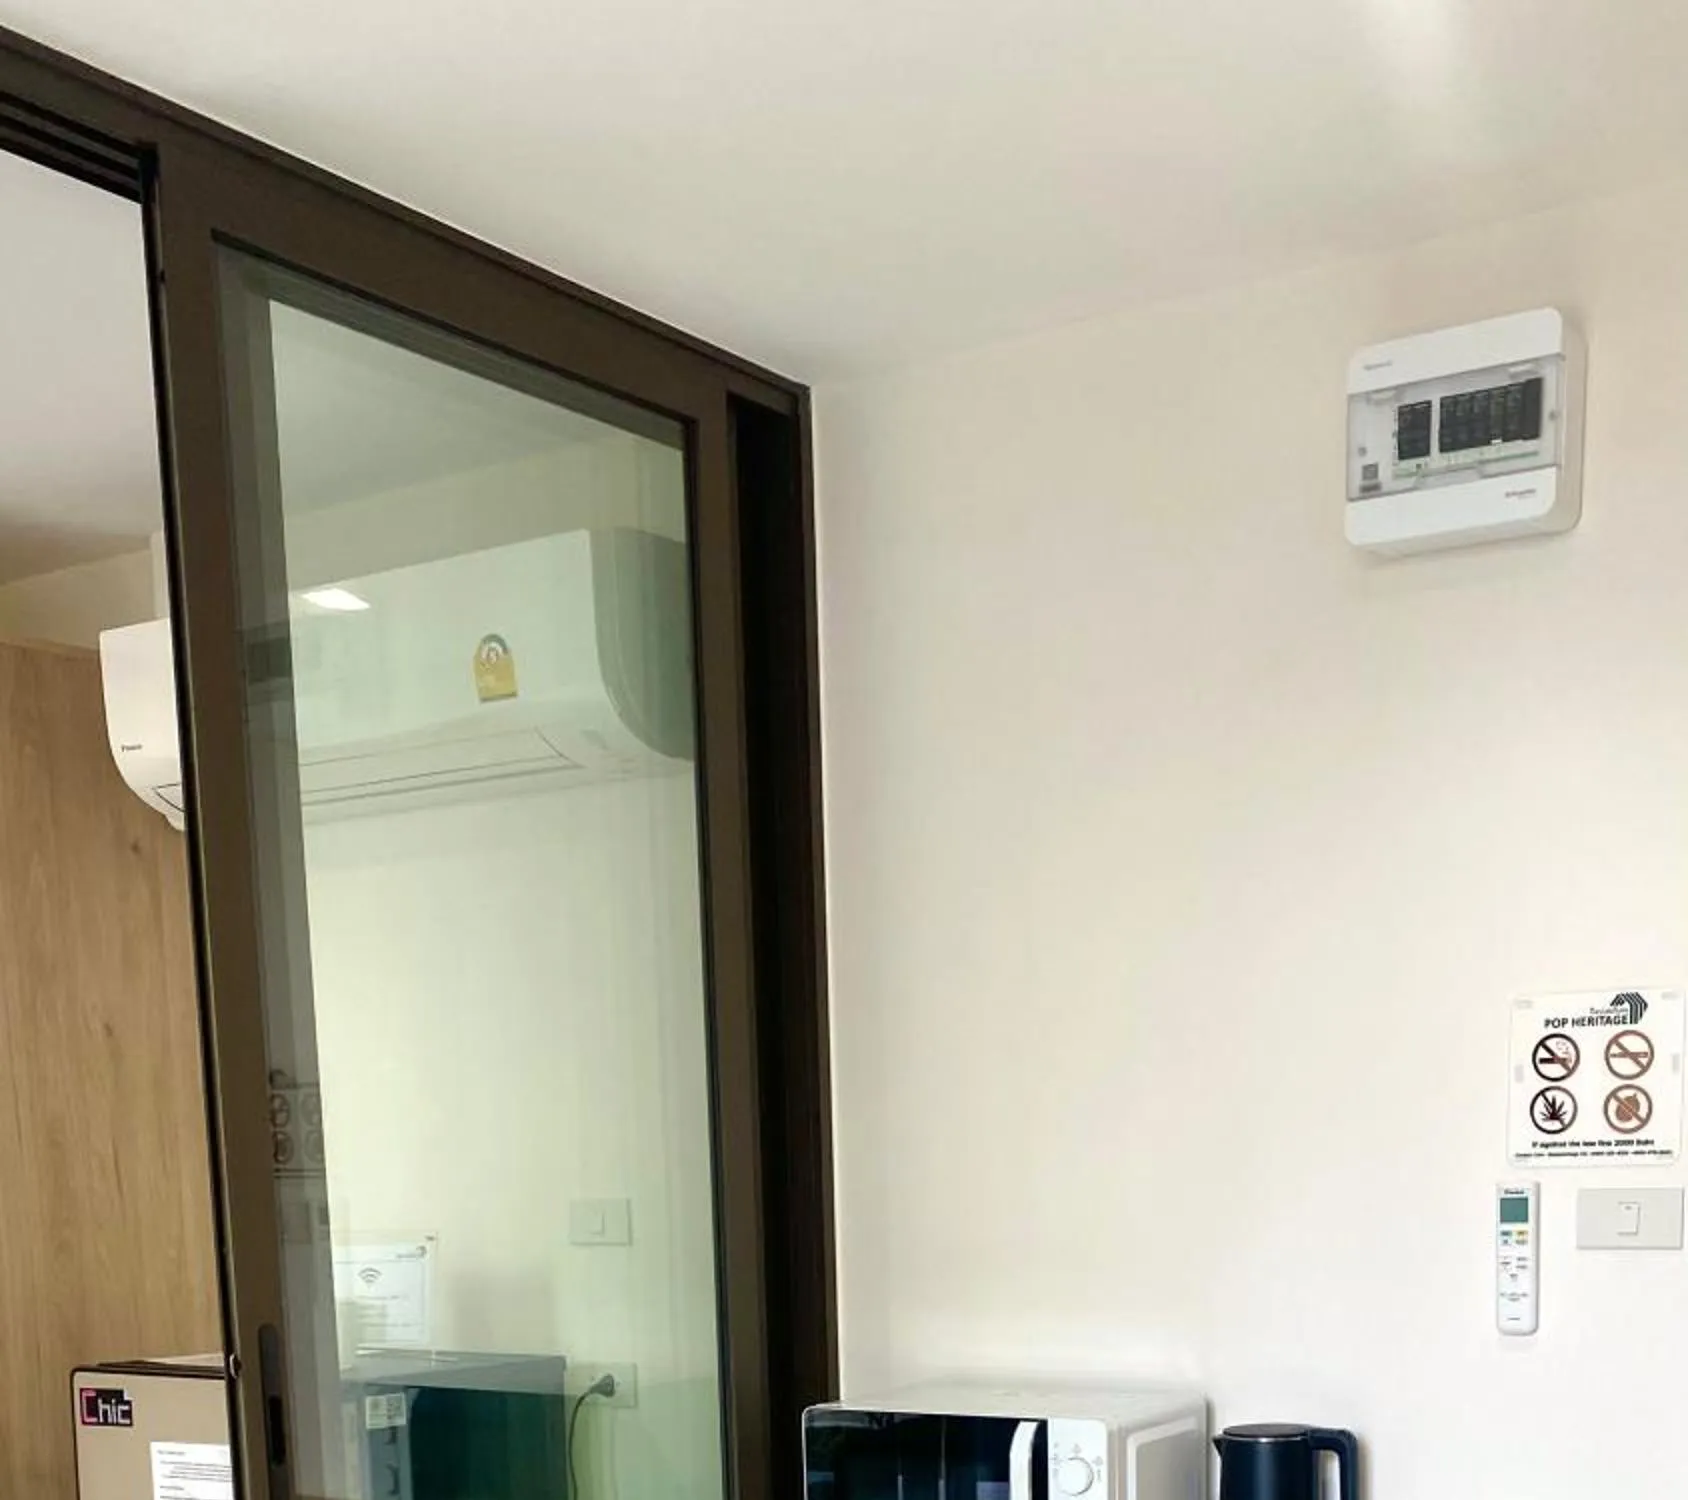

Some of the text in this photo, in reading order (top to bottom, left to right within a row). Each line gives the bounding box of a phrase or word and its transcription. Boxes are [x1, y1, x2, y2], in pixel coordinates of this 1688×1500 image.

[1544, 1015, 1629, 1029] POP HERITAGE
[81, 1389, 131, 1424] Chic
